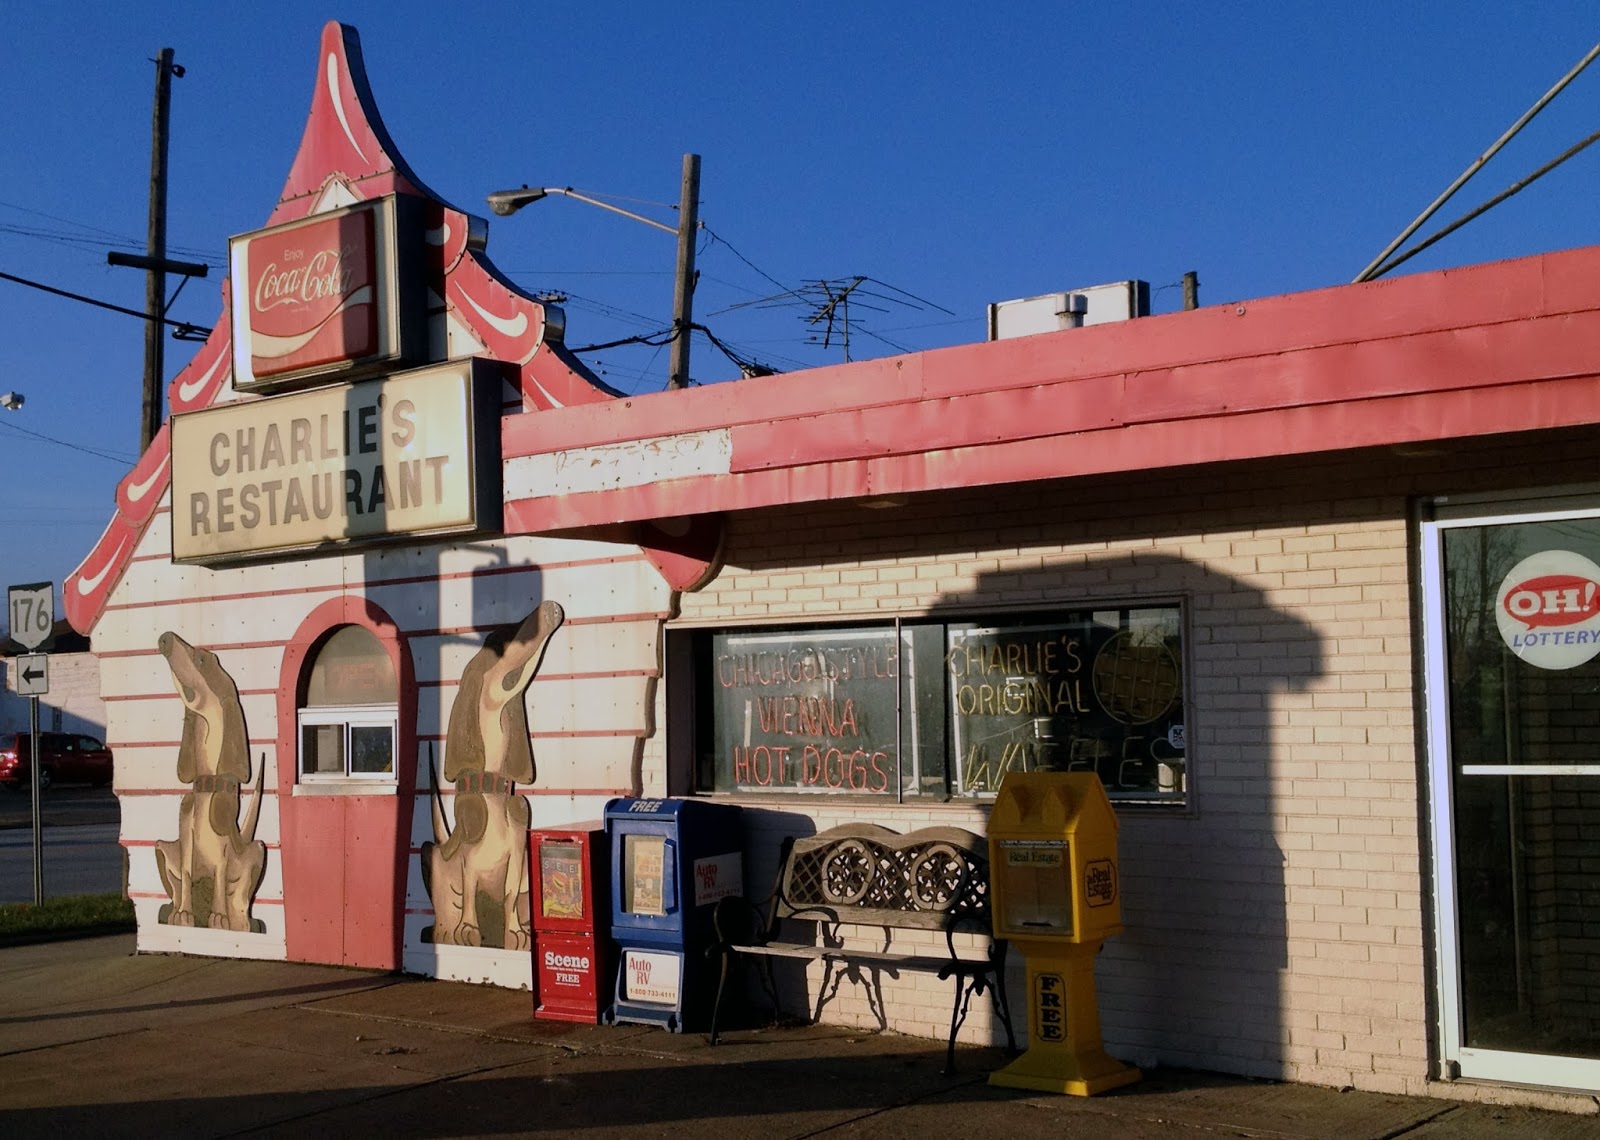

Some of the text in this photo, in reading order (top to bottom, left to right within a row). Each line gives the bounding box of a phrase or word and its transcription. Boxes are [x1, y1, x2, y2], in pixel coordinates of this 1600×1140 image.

[283, 249, 304, 262] Enjoy
[254, 247, 353, 312] Coca-Cola
[209, 393, 417, 477] CHARLIE'S
[190, 455, 450, 537] RESTAURANT
[12, 597, 50, 634] 176
[1508, 581, 1597, 618] OH!
[948, 633, 1082, 678] CHARLIE'S
[1512, 630, 1600, 648] LOTTERY
[718, 642, 897, 689] CHICAGO STYLE
[957, 678, 1091, 716] ORIGINAL
[756, 694, 859, 738] VIENNA
[733, 743, 888, 793] HOT DOGS
[628, 800, 663, 813] FREE
[1009, 851, 1060, 864] Real Estate
[544, 951, 590, 969] Scene
[555, 972, 580, 984] FREE
[628, 957, 652, 972] Auto
[636, 971, 651, 985] RV
[1040, 976, 1062, 1040] FREE
